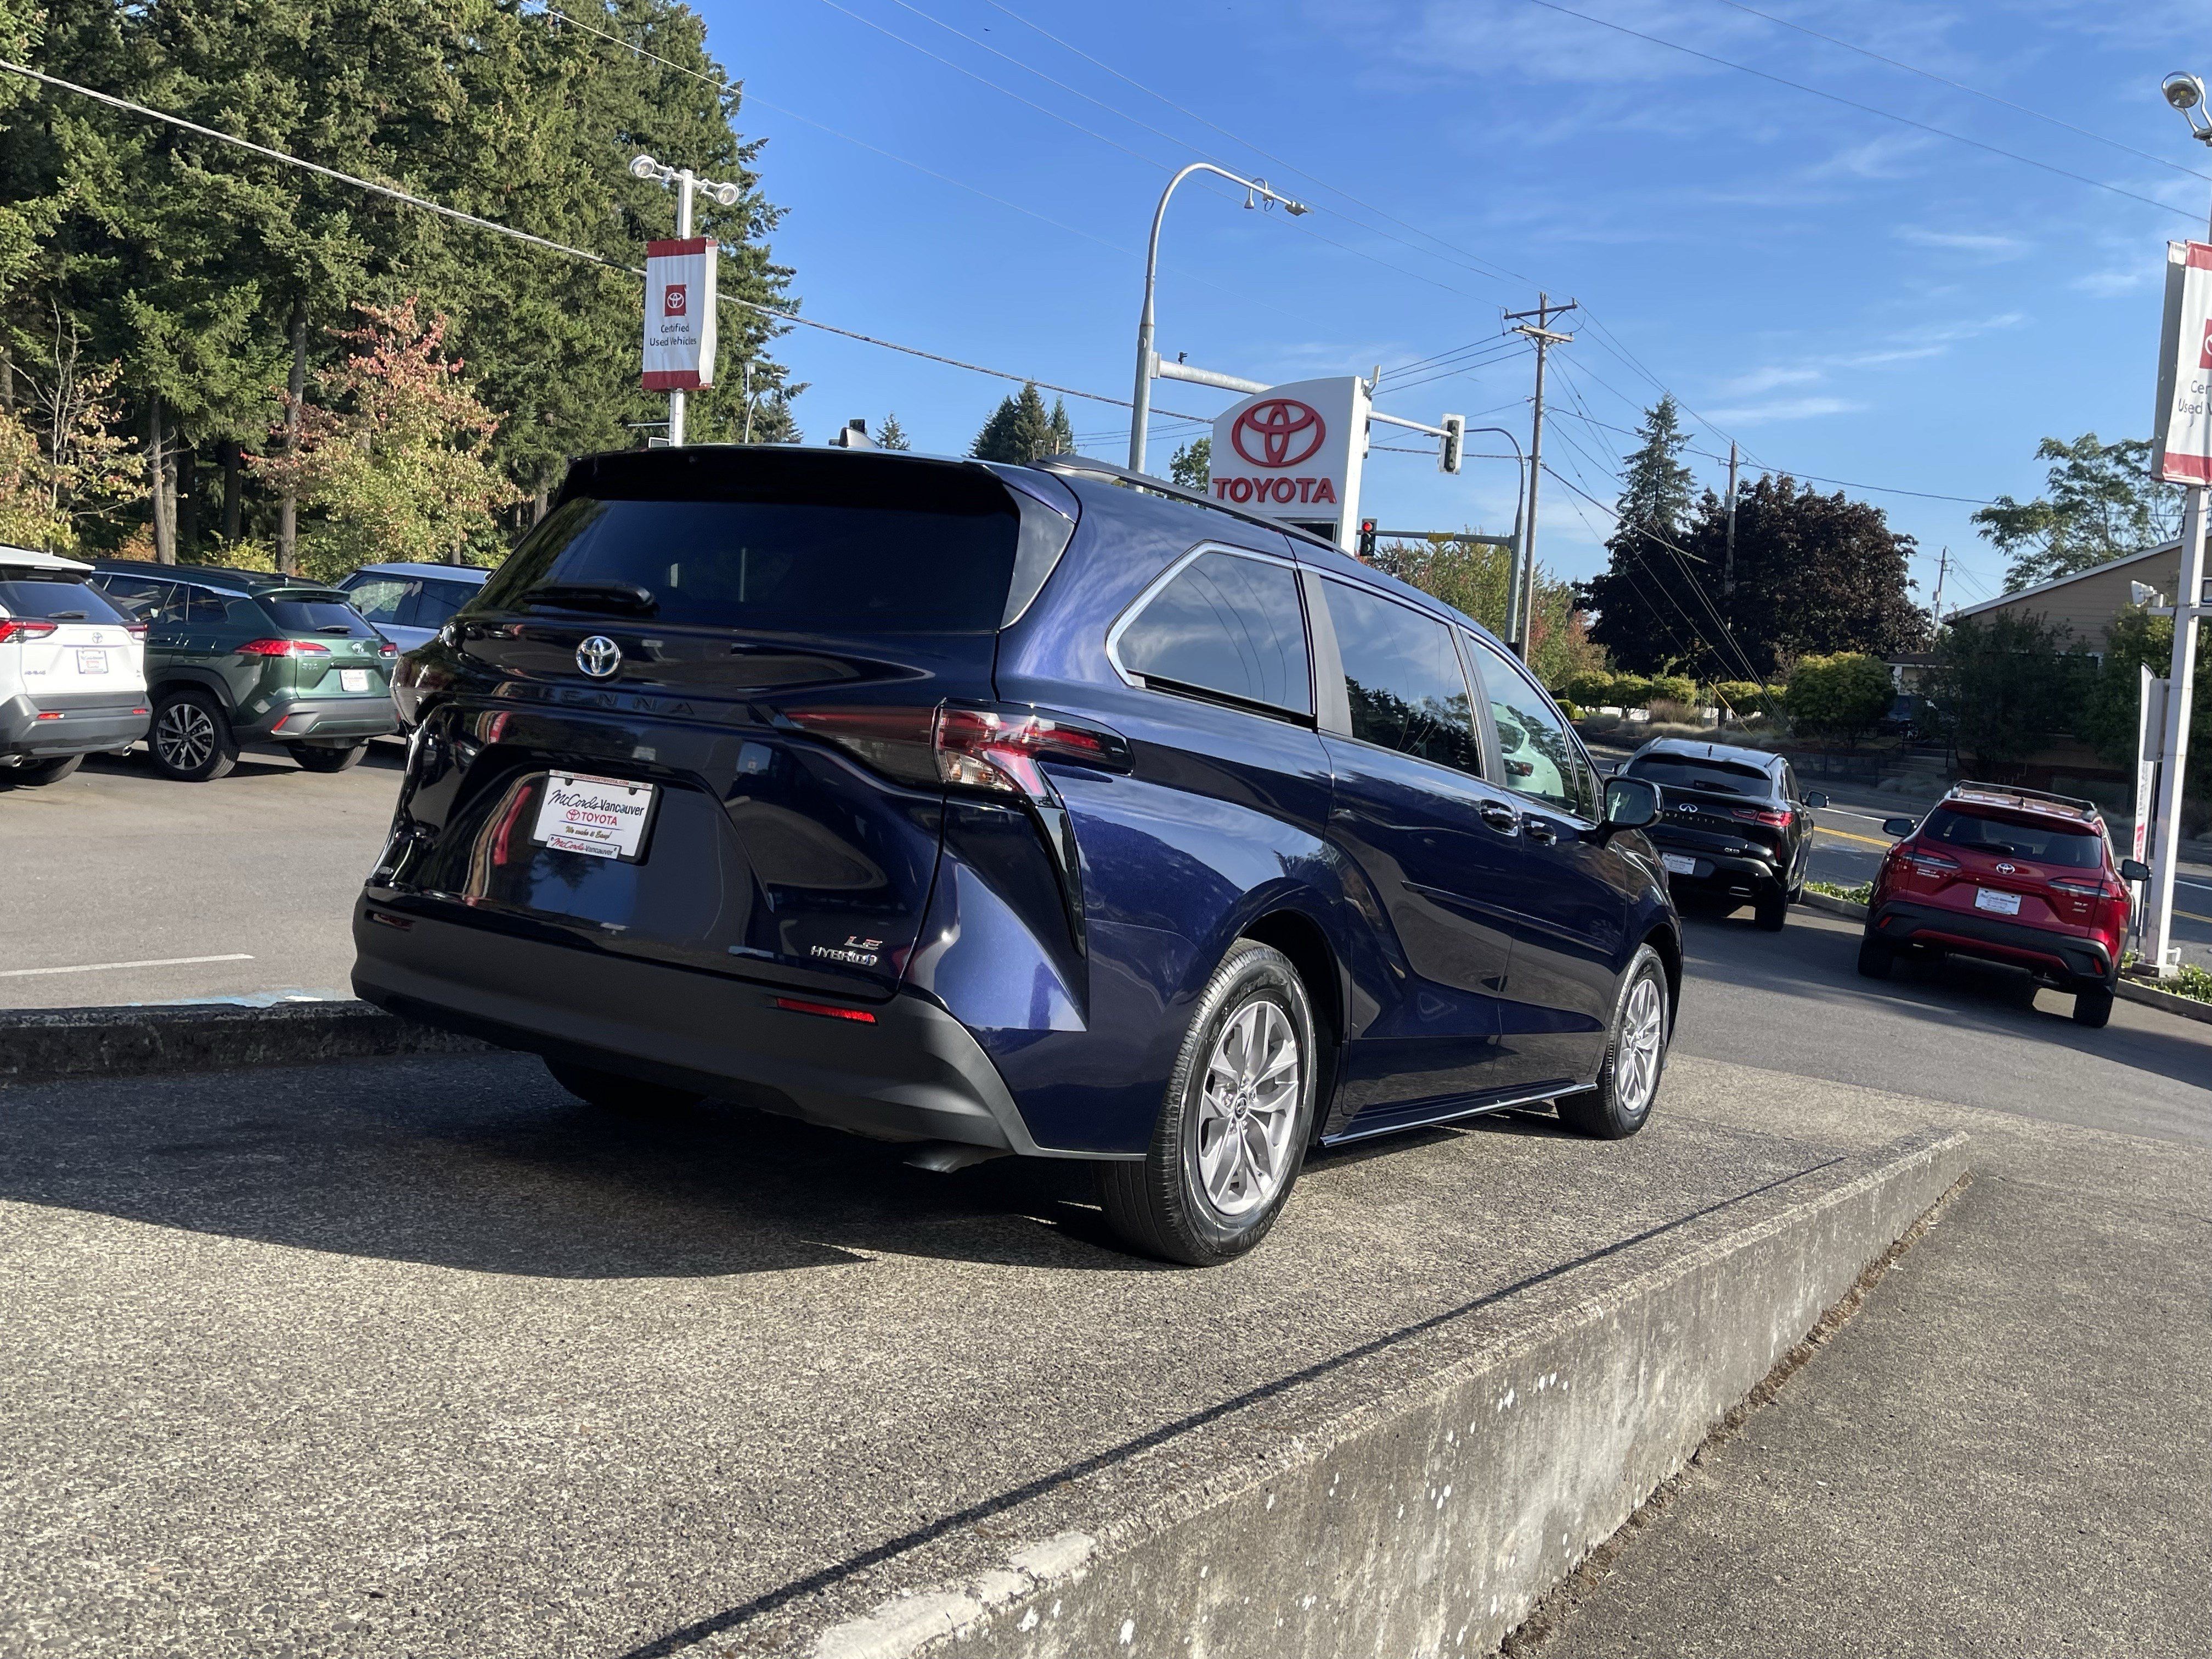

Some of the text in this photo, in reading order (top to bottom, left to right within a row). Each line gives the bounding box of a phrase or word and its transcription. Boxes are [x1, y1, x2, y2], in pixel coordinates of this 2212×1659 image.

[661, 323, 689, 333] Certified
[650, 336, 697, 346] Used Vehicles
[2179, 398, 2203, 415] Used
[1212, 477, 1337, 504] TOYOTA
[582, 811, 617, 826] TOYOTA
[844, 935, 883, 951] LE
[810, 945, 868, 965] HYBRID
